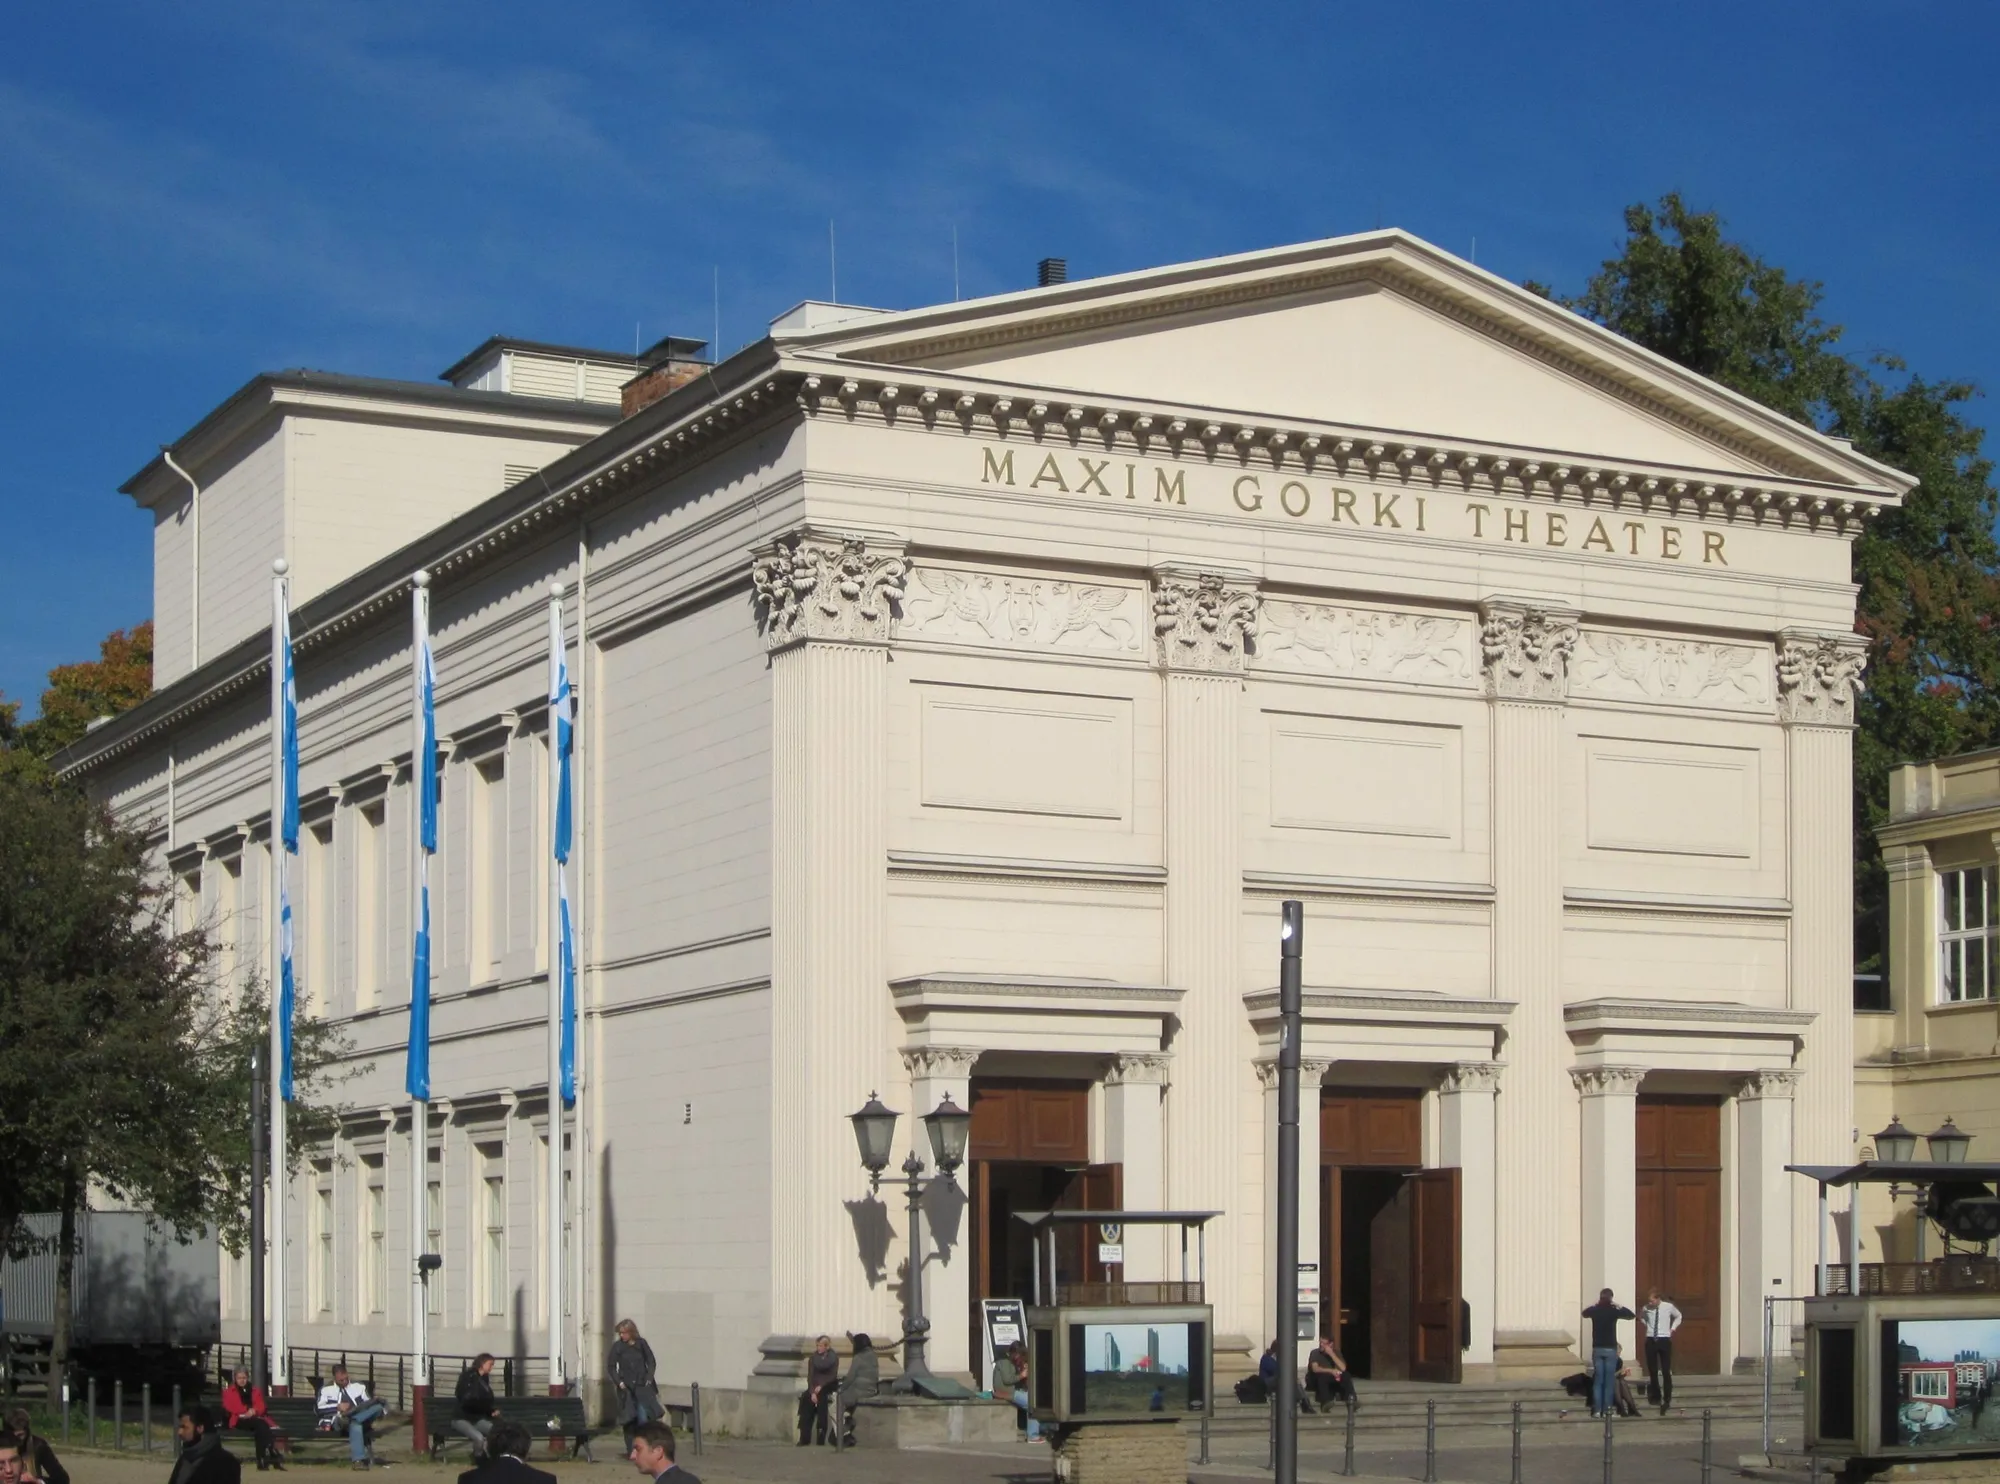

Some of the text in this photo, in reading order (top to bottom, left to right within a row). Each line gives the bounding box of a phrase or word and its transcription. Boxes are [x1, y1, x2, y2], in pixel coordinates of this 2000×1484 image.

[981, 447, 1729, 565] MAXIM GORKI THEATER
